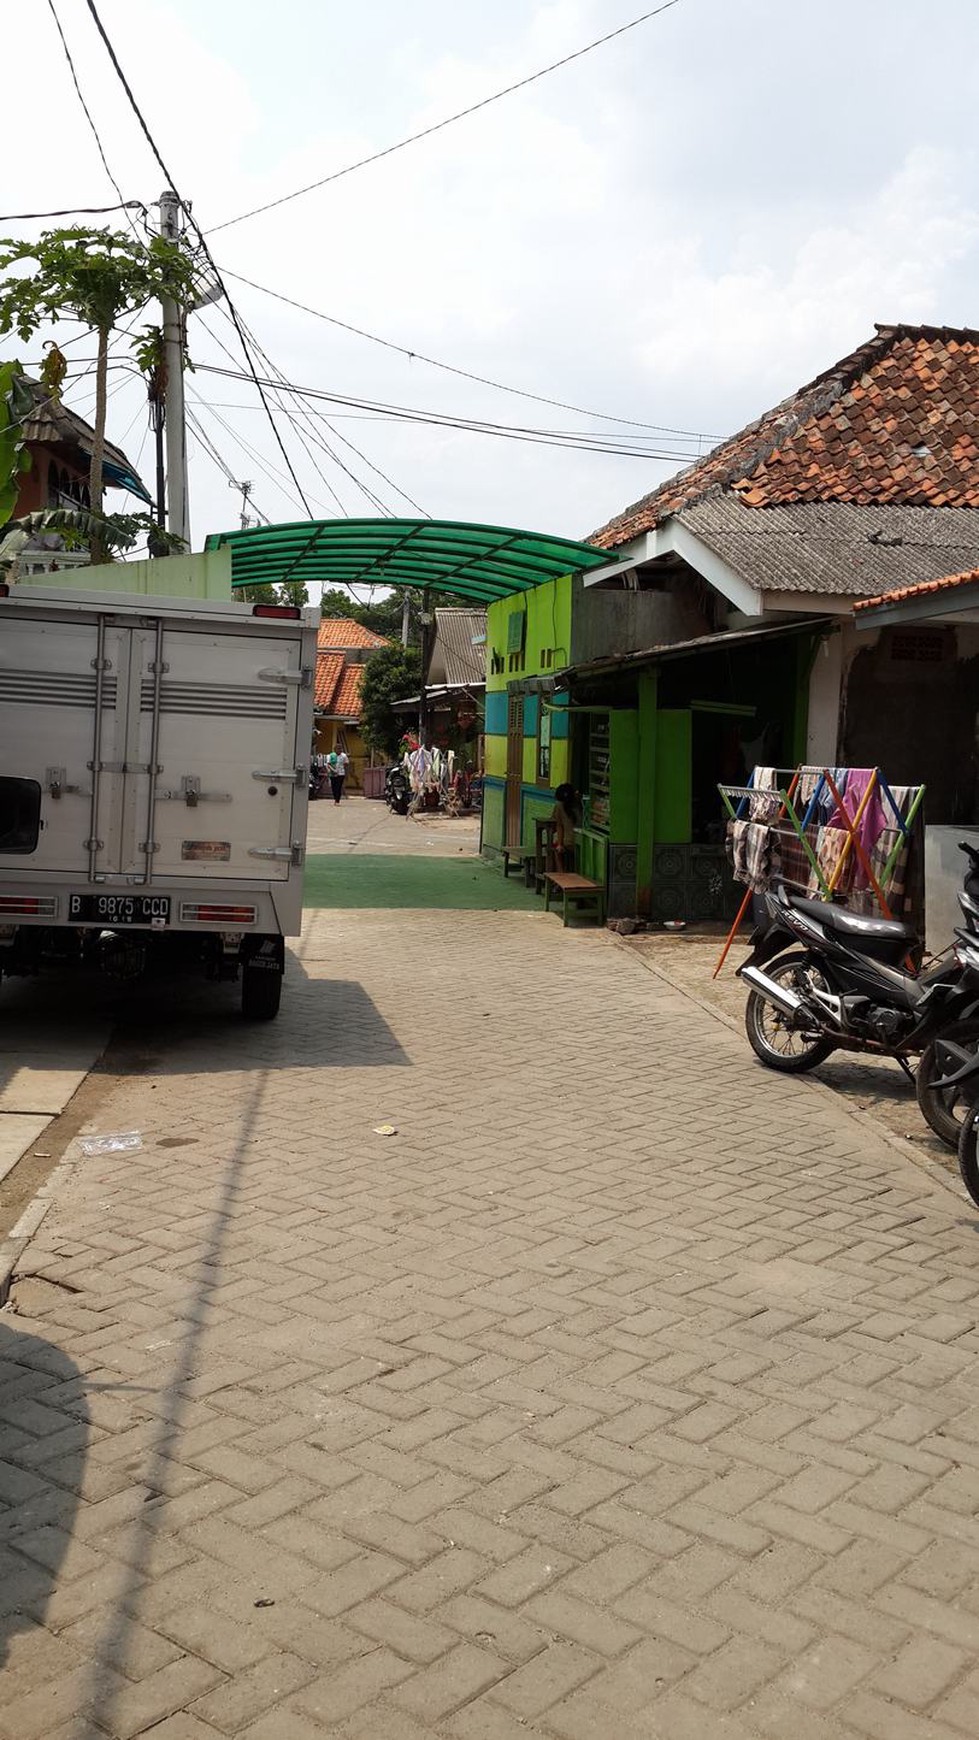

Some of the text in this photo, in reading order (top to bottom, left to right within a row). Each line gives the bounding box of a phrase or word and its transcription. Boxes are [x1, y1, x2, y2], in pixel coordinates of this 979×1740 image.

[71, 895, 169, 916] B 9875 CCD
